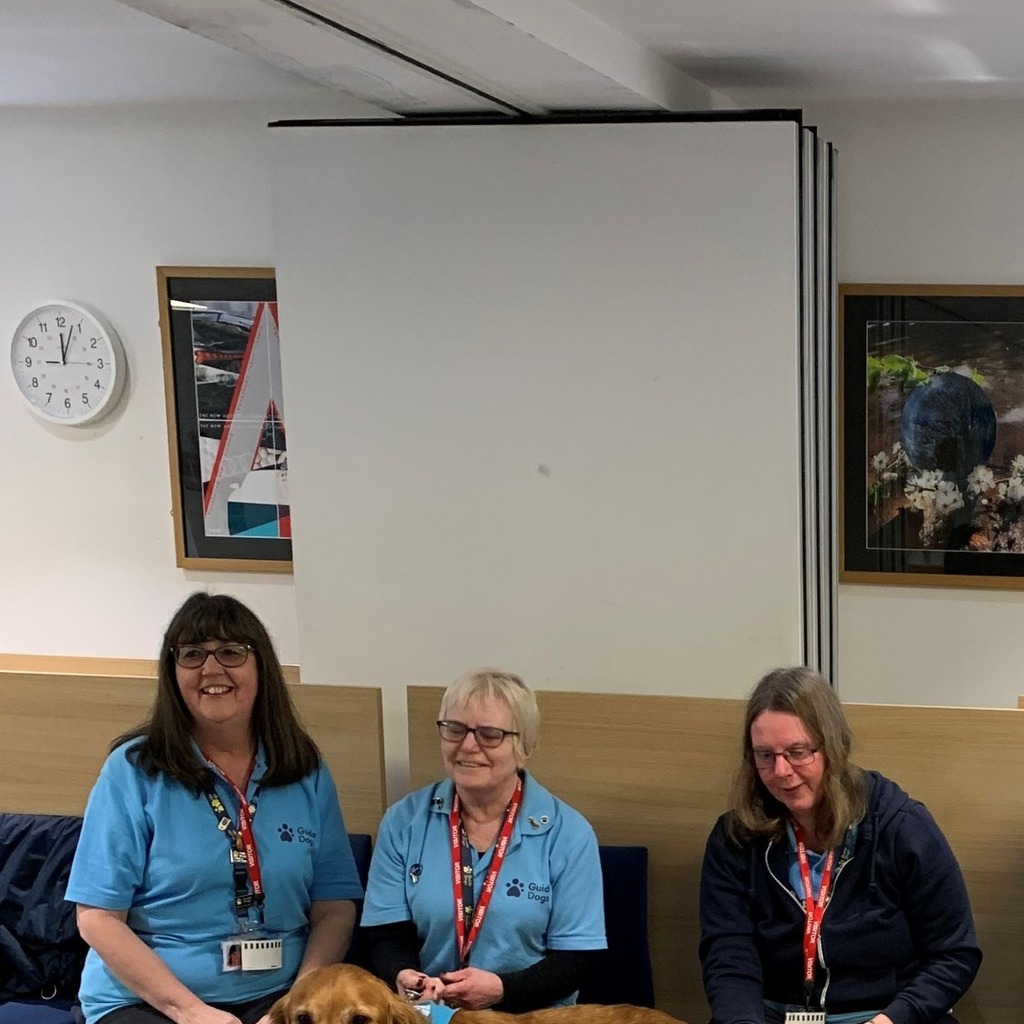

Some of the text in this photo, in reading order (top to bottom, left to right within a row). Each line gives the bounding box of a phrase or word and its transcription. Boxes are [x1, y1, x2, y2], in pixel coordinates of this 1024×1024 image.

[39, 323, 48, 332] 11
[55, 317, 66, 328] 12
[77, 323, 82, 333] 1
[28, 337, 38, 348] 10
[90, 338, 97, 348] 2
[25, 357, 32, 367] 9
[97, 358, 104, 369] 3
[32, 377, 39, 388] 8
[94, 380, 100, 389] 4
[45, 392, 52, 403] 7
[64, 398, 71, 408] 6
[82, 393, 88, 404] 5
[508, 802, 518, 824] VISITOR
[498, 836, 508, 858] VISITOR
[246, 844, 254, 867] VISITOR
[486, 870, 498, 892] VISITOR
[528, 882, 550, 893] Guid
[528, 892, 549, 904] Dogs
[818, 886, 827, 908] VISITOR
[474, 906, 486, 928] VISITOR
[810, 921, 820, 944] VISITOR
